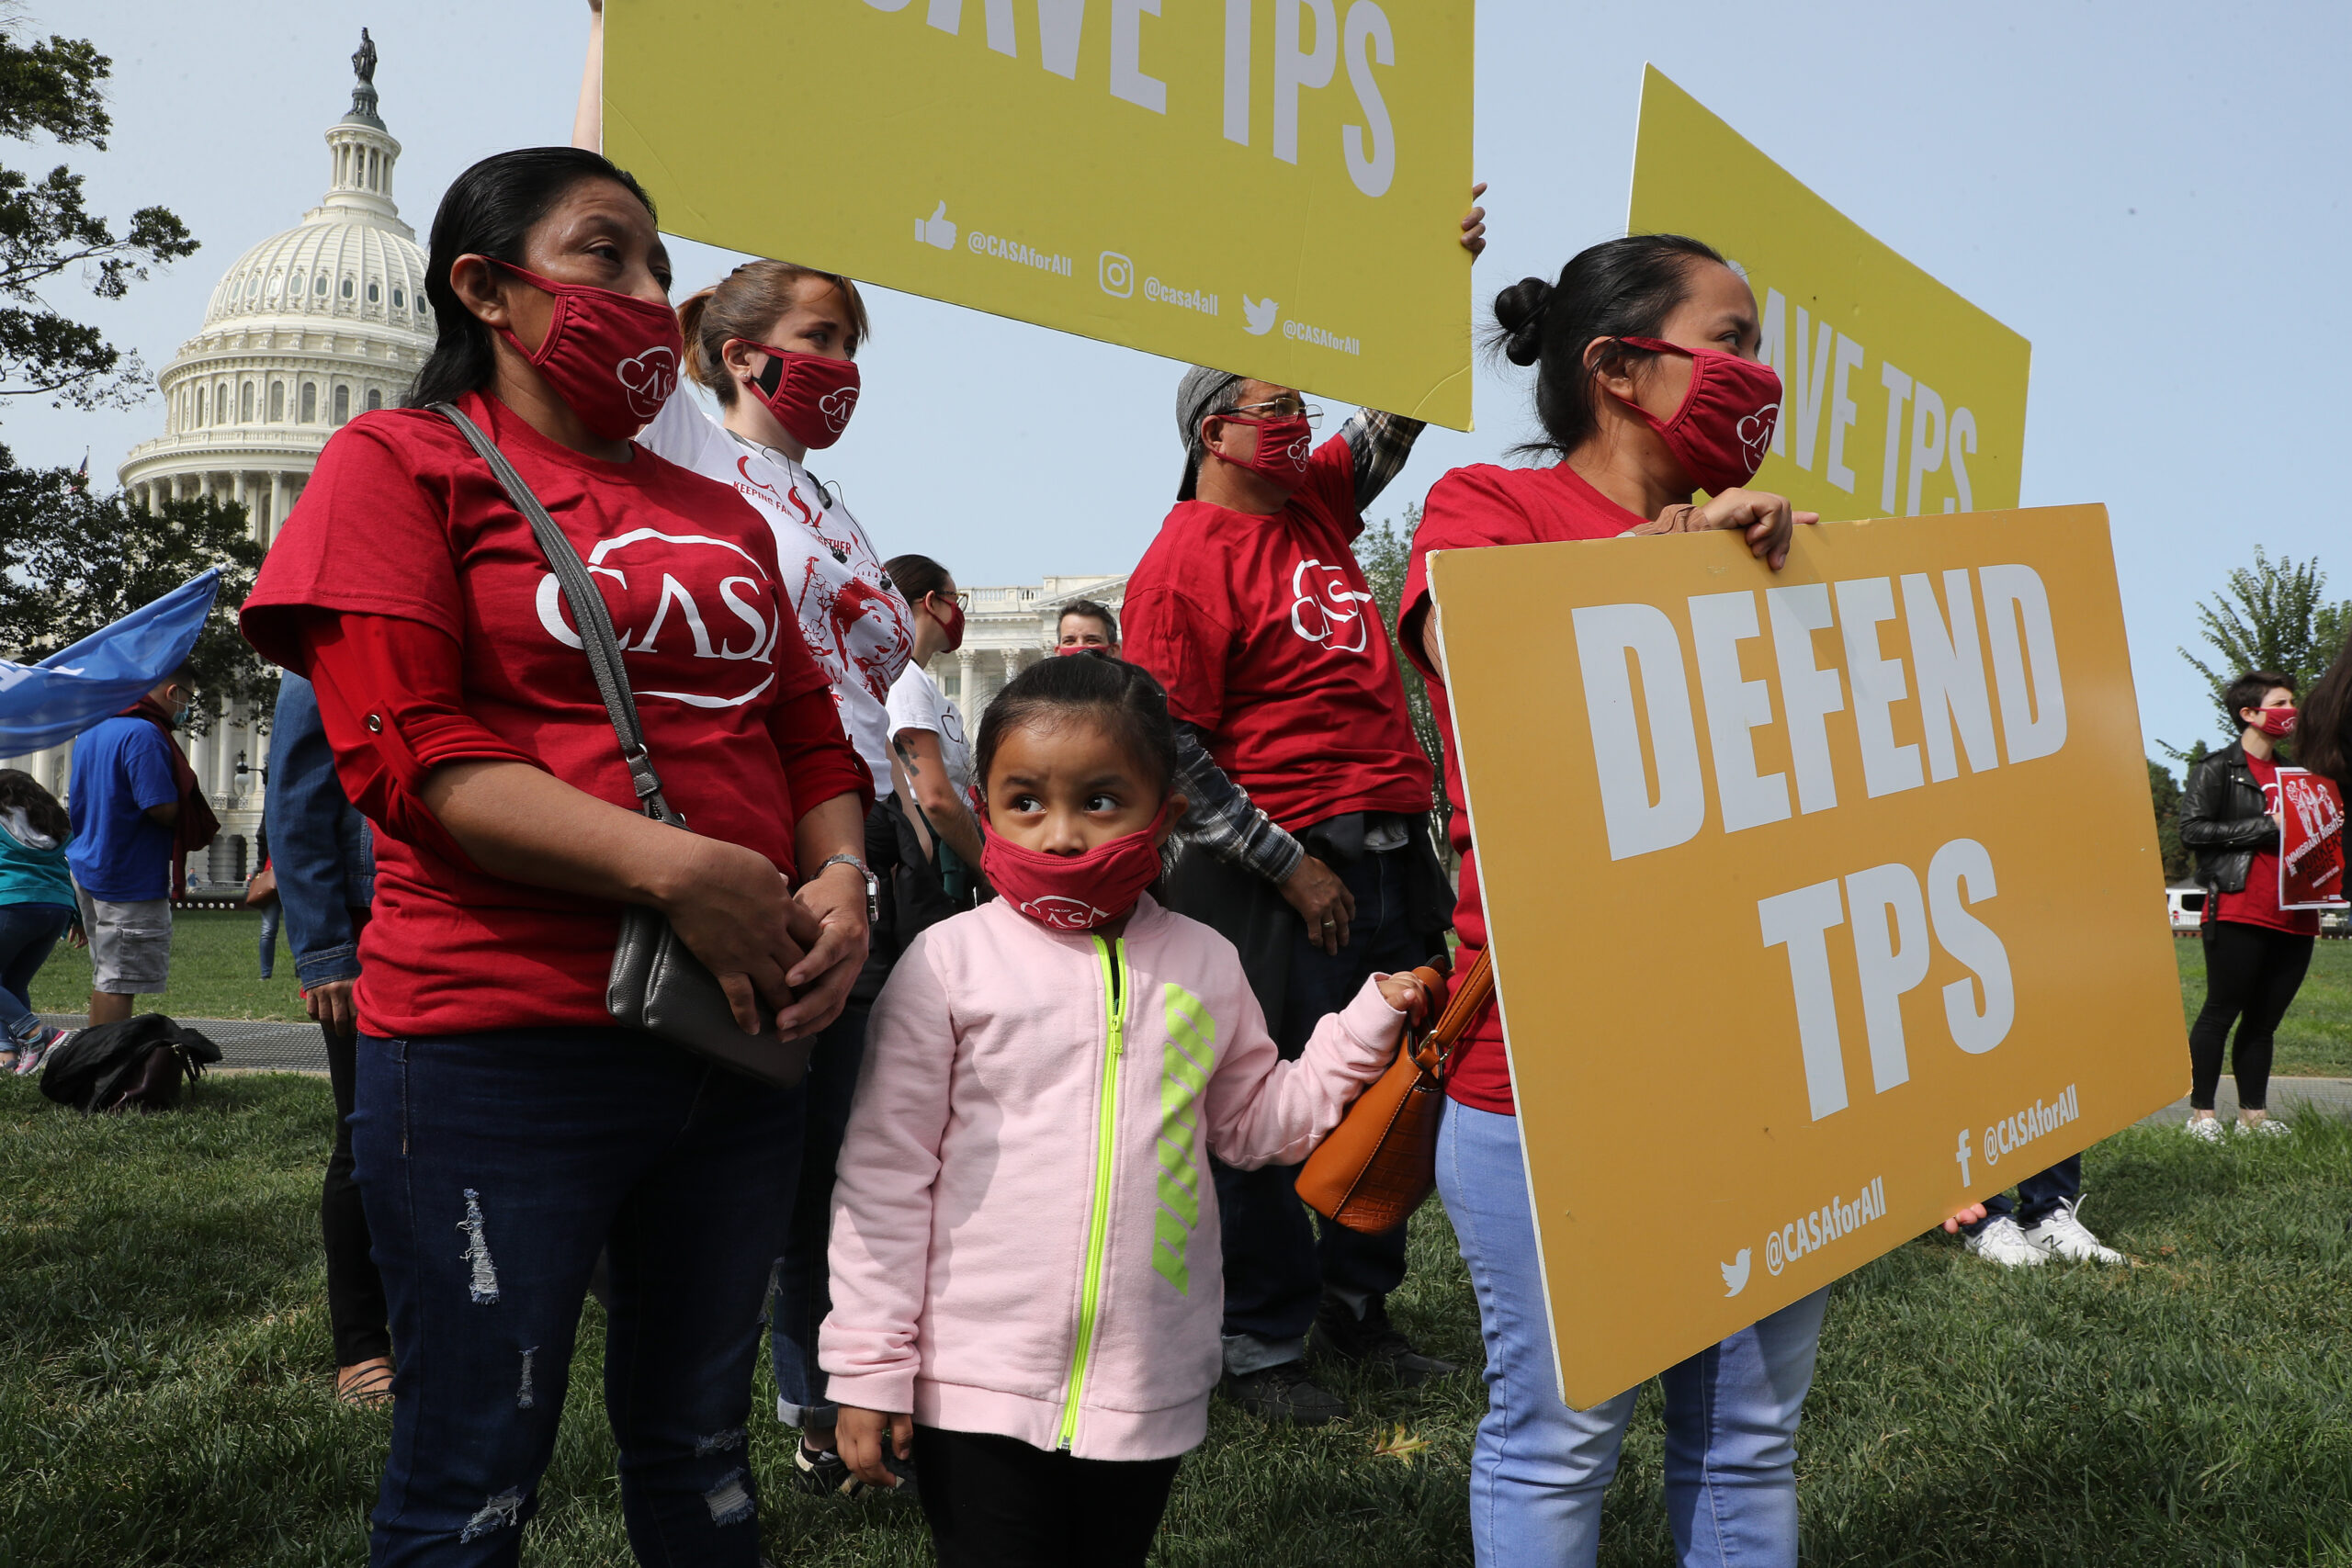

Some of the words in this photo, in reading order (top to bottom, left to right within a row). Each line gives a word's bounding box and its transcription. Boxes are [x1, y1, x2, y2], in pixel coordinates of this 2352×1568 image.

[967, 230, 1072, 277] @CASAforAll
[1143, 276, 1218, 317] @casa4all
[1283, 319, 1361, 356] @CASAforAll
[1727, 260, 1864, 494] AVE
[1881, 360, 1977, 516] TPS
[1571, 563, 2068, 862] DEFEND
[1757, 838, 2016, 1122] TPS
[1984, 1083, 2079, 1166] @CASAforAll
[1766, 1175, 1887, 1277] @CASAforAll
